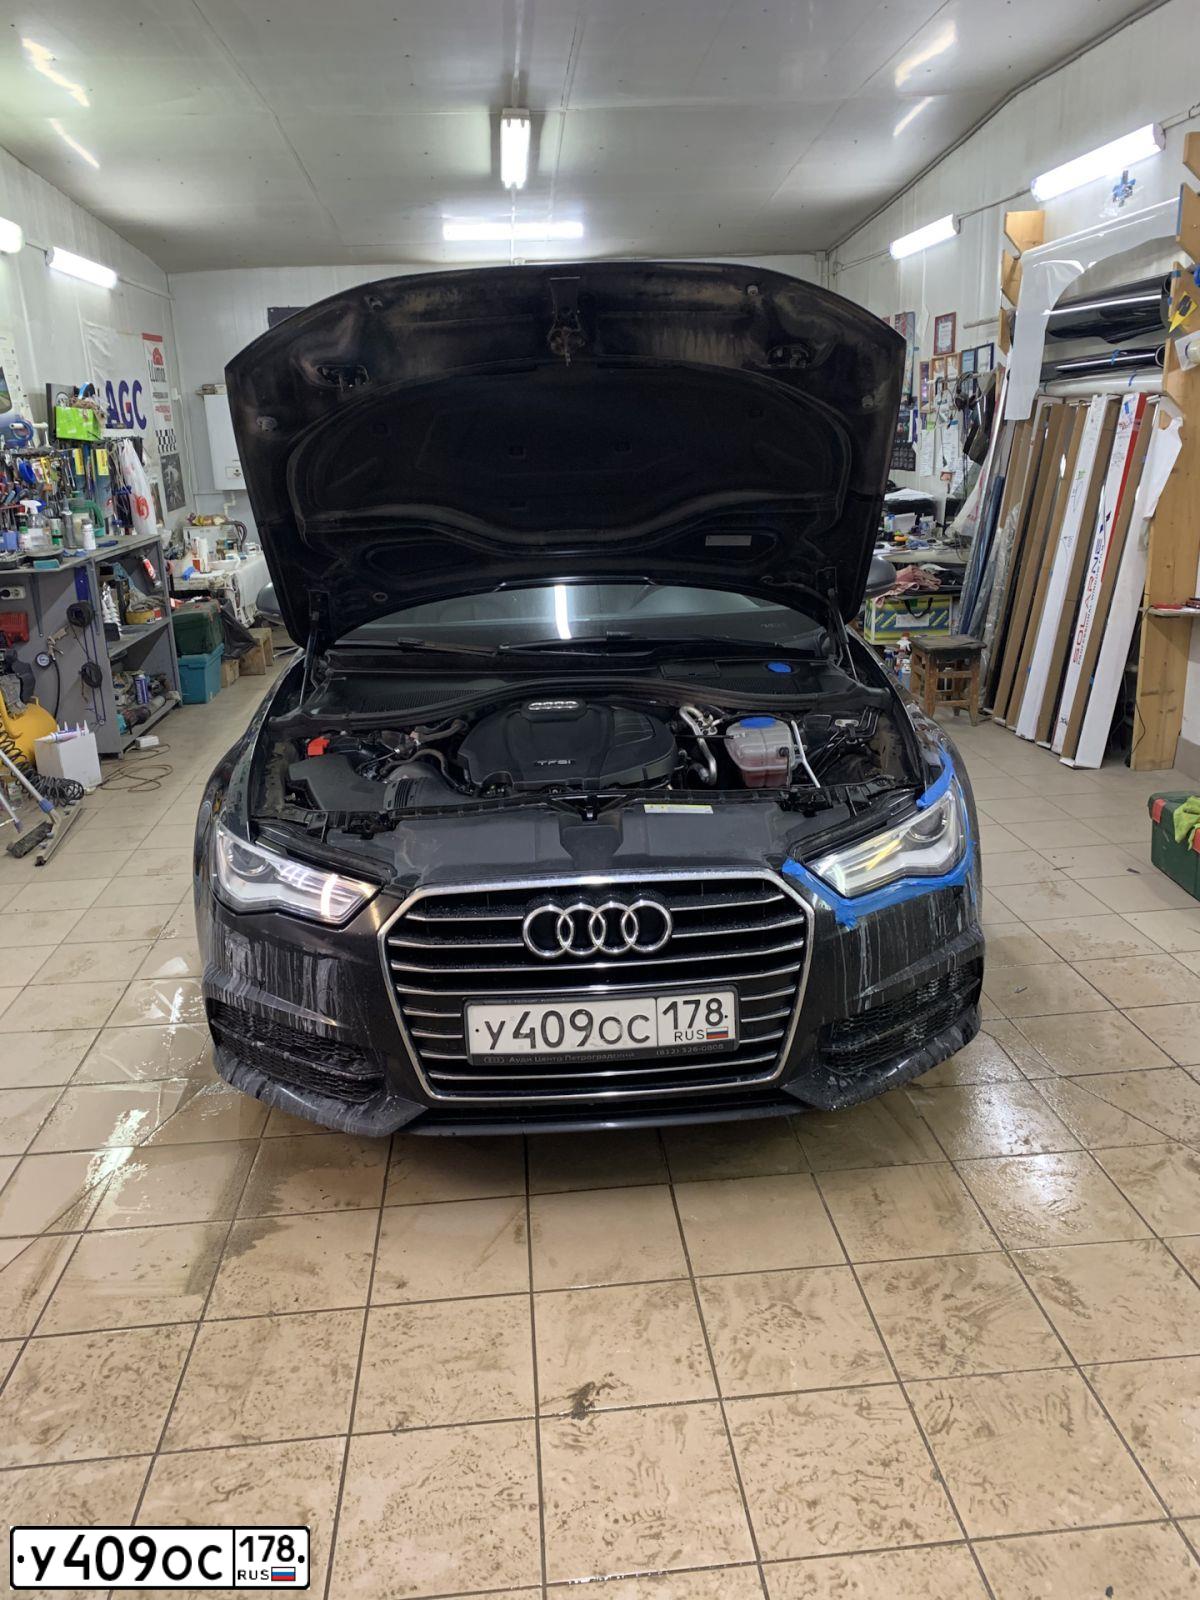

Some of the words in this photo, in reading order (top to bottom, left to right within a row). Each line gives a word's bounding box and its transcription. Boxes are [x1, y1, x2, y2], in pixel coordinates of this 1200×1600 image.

[105, 379, 147, 430] AGC
[662, 998, 723, 1030] 178
[674, 1030, 705, 1042] RUS
